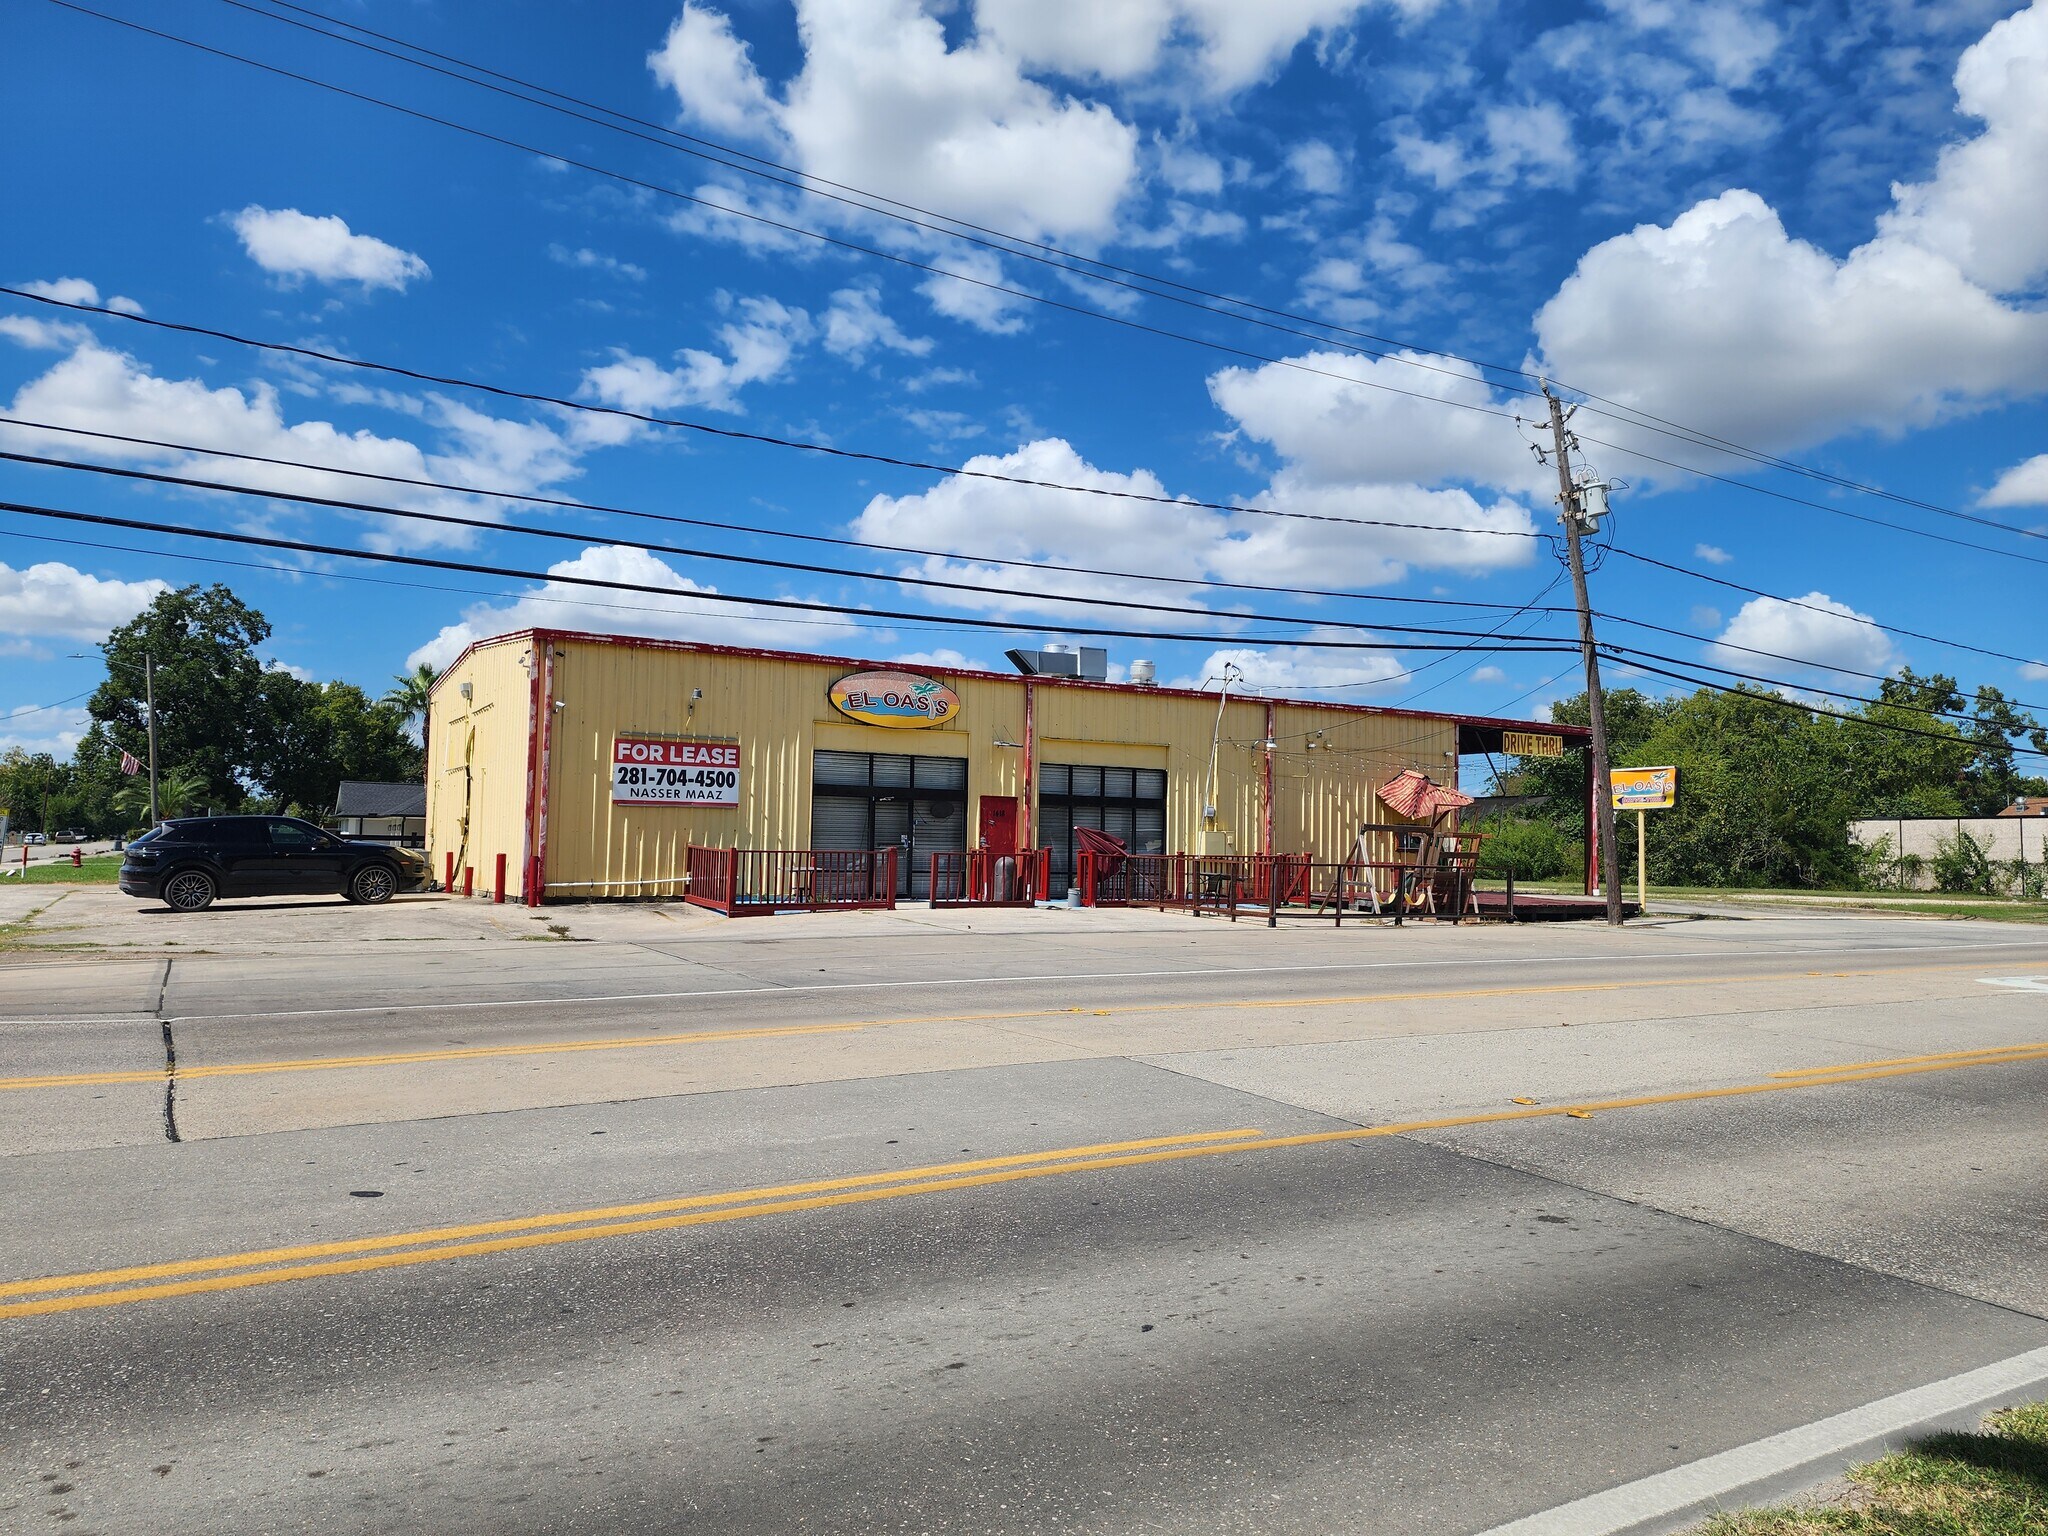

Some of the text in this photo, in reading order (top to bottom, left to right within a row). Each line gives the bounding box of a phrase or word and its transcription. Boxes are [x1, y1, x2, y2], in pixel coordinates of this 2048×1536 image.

[847, 690, 949, 717] EL OASIS
[617, 743, 737, 765] FOR LEASE
[1504, 733, 1562, 757] DRIVE THRU
[617, 766, 736, 788] 281-704-4500
[630, 787, 723, 800] NASSER MAAZ
[1612, 783, 1630, 795] EL
